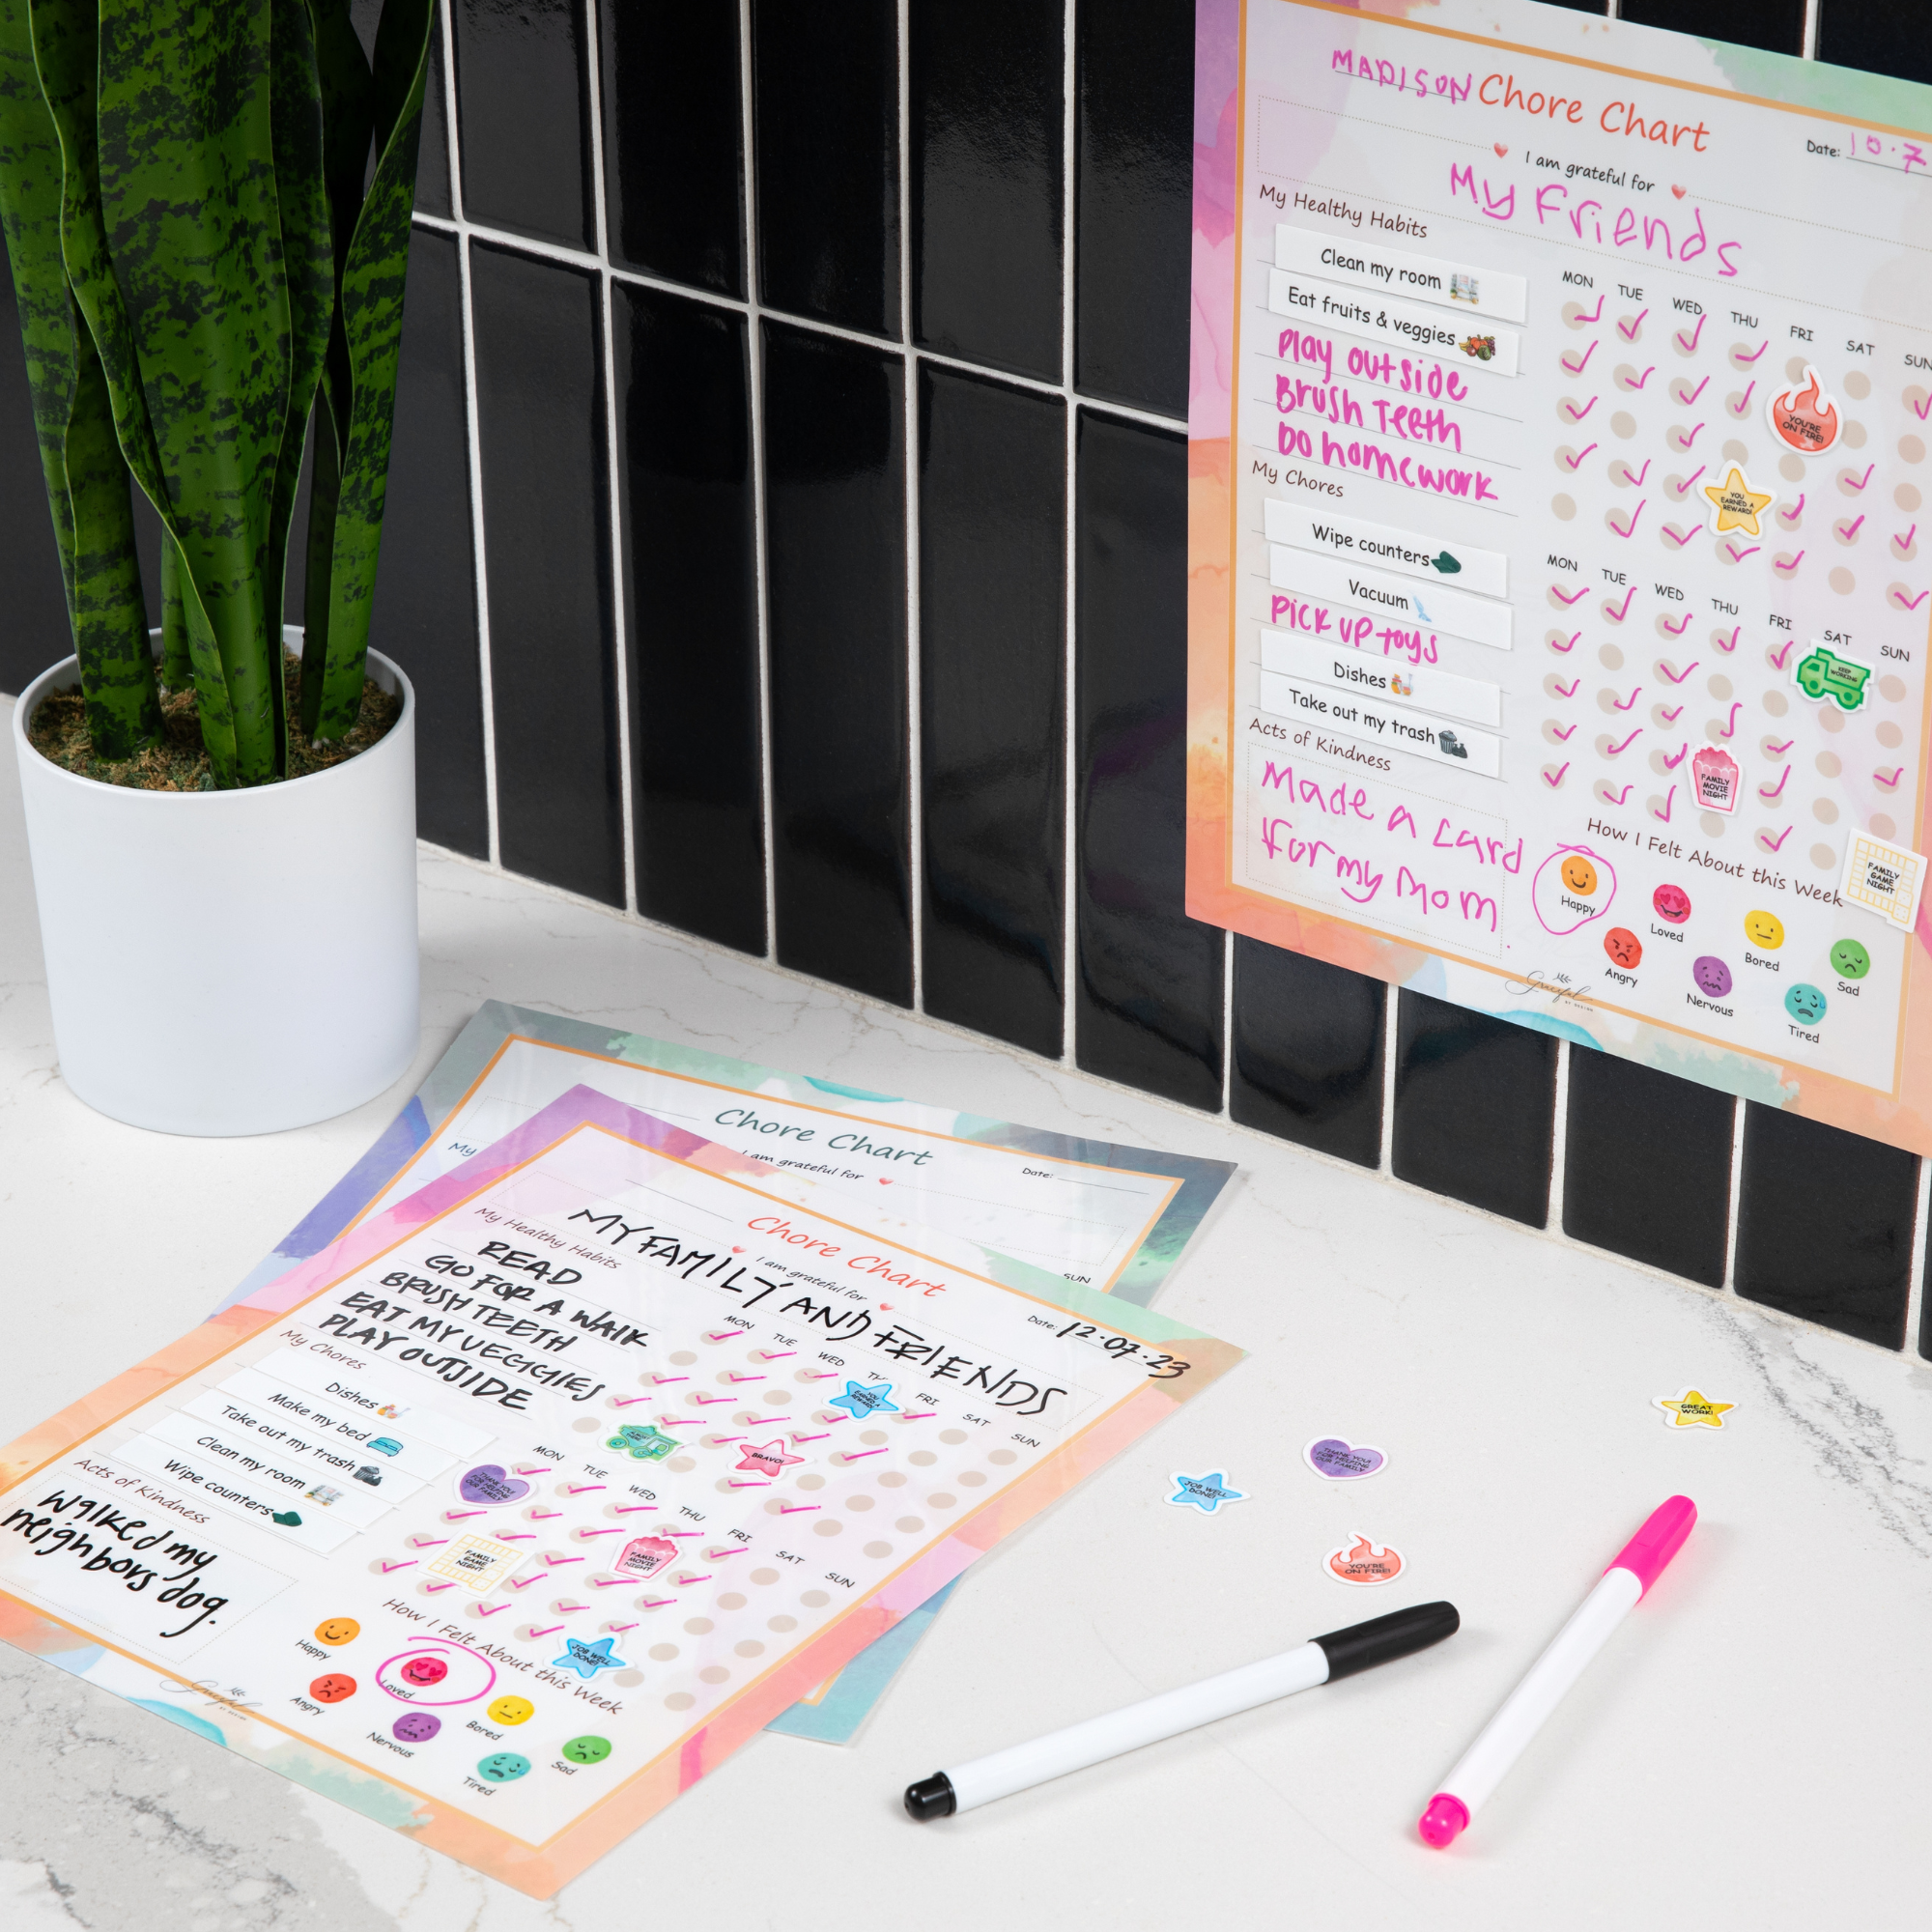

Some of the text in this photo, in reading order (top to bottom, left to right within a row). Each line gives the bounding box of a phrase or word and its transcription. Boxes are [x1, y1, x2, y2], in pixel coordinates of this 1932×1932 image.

[1332, 49, 1472, 104] MADISON
[1479, 73, 1710, 152] Chore Chart
[1806, 139, 1840, 157] Date:
[1525, 151, 1655, 192] I am grateful for
[1260, 184, 1428, 239] My Healthy Habits
[1536, 184, 1742, 276] Friends
[1321, 248, 1441, 290] Clean my room
[1289, 286, 1456, 346] Eat fruits & veggies
[1562, 270, 1932, 370] MON TUE WED THU FRI SAT SUN
[1782, 421, 1824, 443] ON FIRE!
[1789, 414, 1822, 434] YOU'RE
[1252, 460, 1344, 497] My Chores
[1720, 497, 1747, 507] EARNED
[1730, 492, 1745, 500] YOU
[1722, 504, 1752, 515] REWARD!
[1312, 523, 1430, 567] Wipe counters
[1349, 579, 1408, 611] Vacuum
[1334, 662, 1386, 689] Dishes
[1831, 669, 1858, 682] WORKING
[1289, 688, 1435, 745] Take out my trash
[1249, 718, 1391, 771] Acts of Kindness
[1701, 774, 1730, 786] FAMILY
[1703, 781, 1728, 793] MOVIE
[1702, 789, 1728, 801] NIGHT
[1587, 817, 1844, 908] How I Felt About this Week
[1867, 862, 1900, 881] FAMILY
[1866, 877, 1895, 895] NIGHT
[1870, 870, 1894, 887] GAME
[1561, 895, 1596, 917] Happy
[1651, 923, 1684, 943] Loved
[1745, 952, 1780, 972] Bored
[1605, 968, 1638, 988] Angry
[1836, 980, 1860, 997] Sad
[1687, 993, 1734, 1017] Nervous
[1788, 1024, 1820, 1044] Tired
[715, 1109, 934, 1166] Chore Chart
[448, 1142, 478, 1157] My
[1022, 1167, 1053, 1179] Date:
[474, 1208, 622, 1269] My Healthy Habits
[477, 1240, 582, 1286] READ
[748, 1216, 947, 1297] Chore Chart
[425, 1255, 475, 1278] GO
[469, 1273, 535, 1302] FOR
[533, 1299, 564, 1316] A
[340, 1291, 412, 1322] EAT
[408, 1316, 464, 1343] MY
[380, 1271, 579, 1352] BRUSH TEETH
[567, 1208, 1068, 1415] MY FAMILY AND FRIENDS
[319, 1314, 410, 1351] PLAY
[1027, 1315, 1058, 1331] Date:
[279, 1329, 367, 1371] My Chores
[326, 1381, 380, 1409] Dishes
[268, 1393, 373, 1442] Make my bed
[751, 1452, 785, 1465] BRAVO!
[1315, 1456, 1366, 1473] OUR FAMILY
[1316, 1451, 1370, 1469] FOR HELPING
[1323, 1447, 1372, 1464] THANK YOU!
[73, 1459, 211, 1524] Acts of Kindness
[1184, 1480, 1228, 1497] JOB WELL
[1189, 1488, 1216, 1499] DONE!
[162, 1542, 218, 1581] my
[295, 1639, 331, 1662] Happy
[572, 1644, 611, 1666] JOB WELL
[573, 1652, 600, 1667] DONE!
[379, 1679, 416, 1700] Loved
[290, 1695, 326, 1717] Angry
[466, 1720, 504, 1742] Bored
[366, 1731, 415, 1759] Nervous
[552, 1760, 579, 1776] Sad
[463, 1776, 497, 1797] Tired
